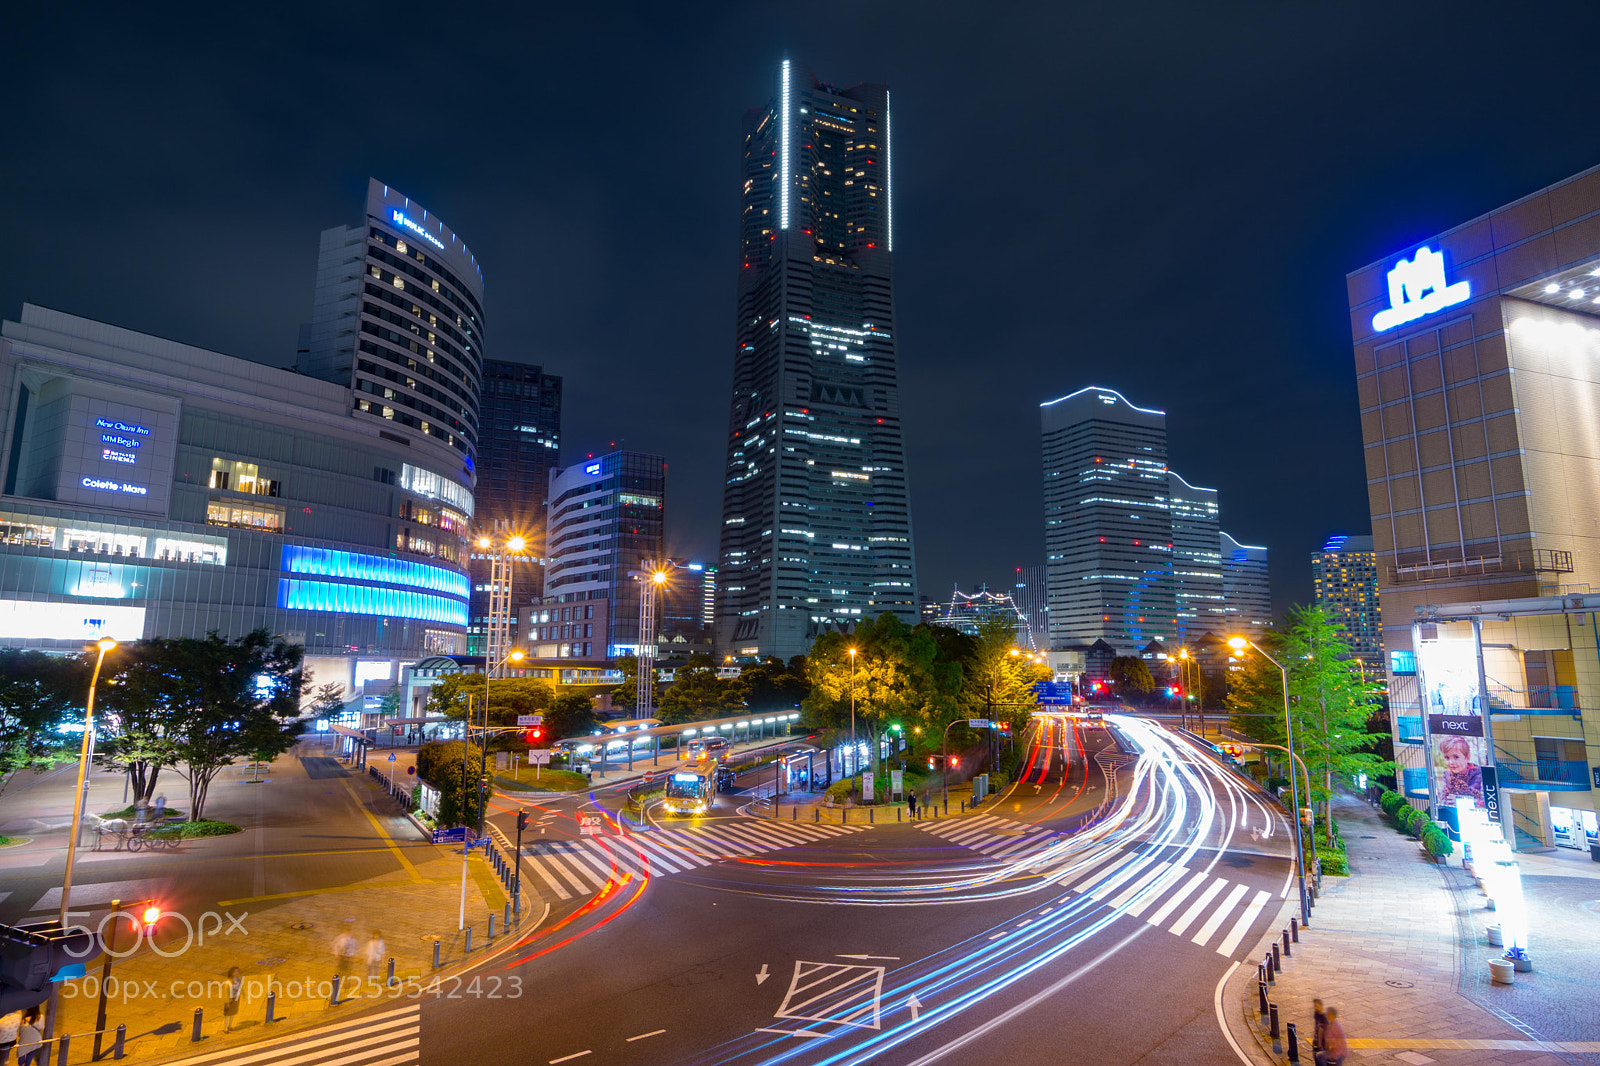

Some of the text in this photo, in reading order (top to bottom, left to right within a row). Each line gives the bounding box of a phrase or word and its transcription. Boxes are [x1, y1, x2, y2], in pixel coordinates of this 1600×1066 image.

[96, 418, 113, 428] New
[136, 426, 149, 435] Inn
[103, 454, 135, 464] CINEMA
[1442, 720, 1470, 731] next
[1486, 784, 1499, 820] next
